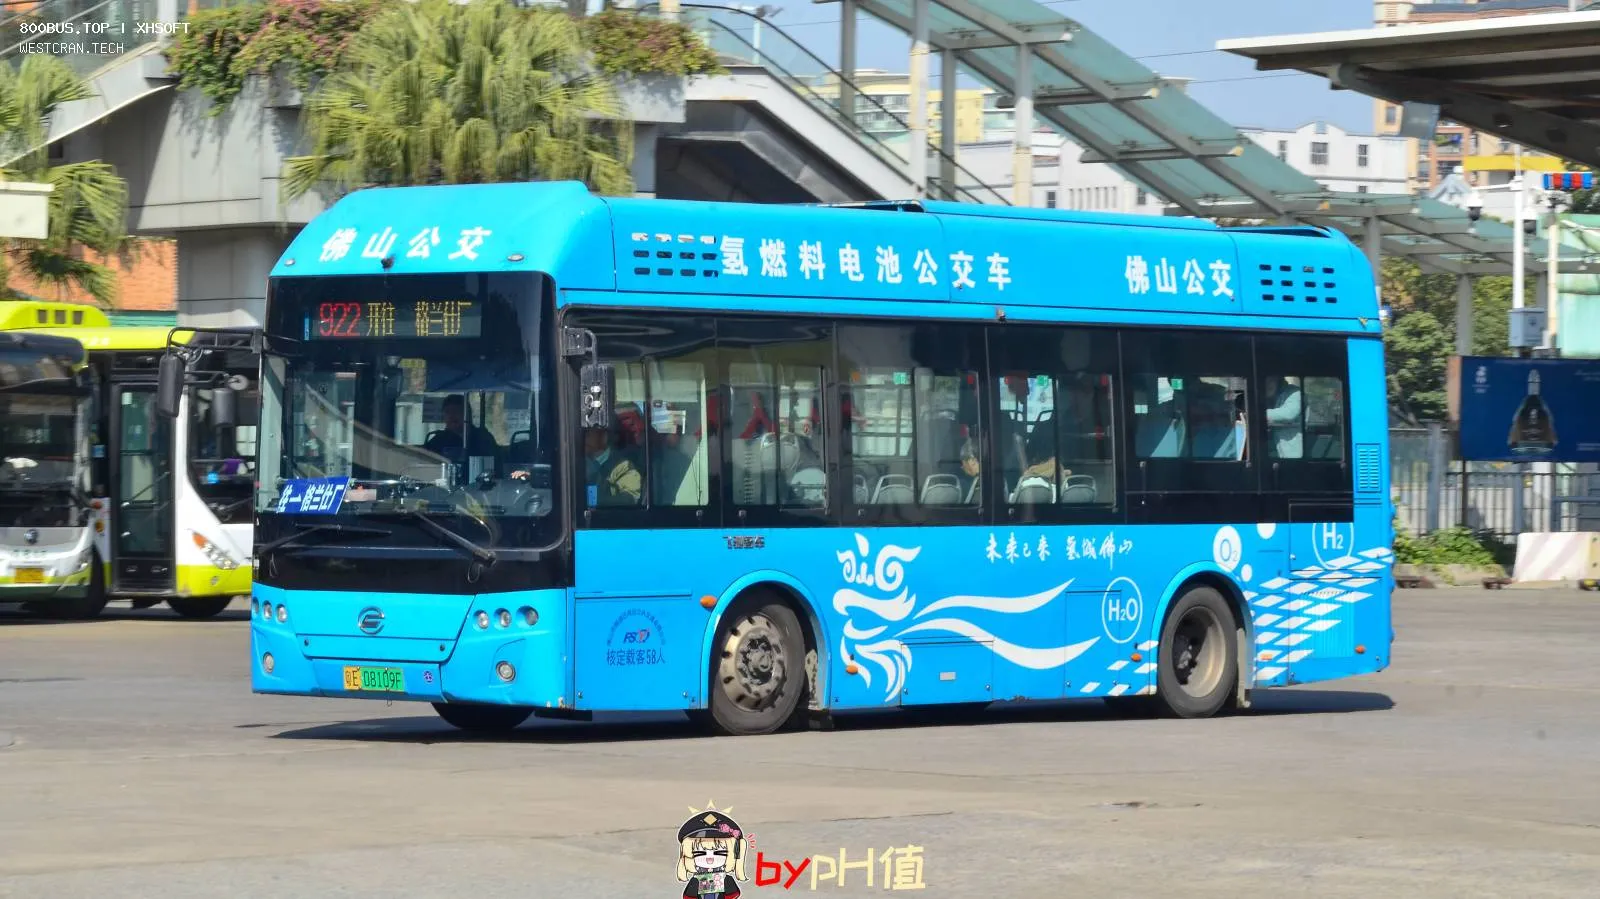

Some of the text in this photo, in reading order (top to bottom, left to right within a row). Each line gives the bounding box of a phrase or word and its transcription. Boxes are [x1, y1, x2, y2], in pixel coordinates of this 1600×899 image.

[319, 226, 493, 262] 佛山公交
[719, 234, 1012, 291] 氢燃料电池公交车
[1124, 255, 1235, 298] 佛山公交
[319, 301, 362, 336] 922
[606, 648, 665, 666] 核定载客58人
